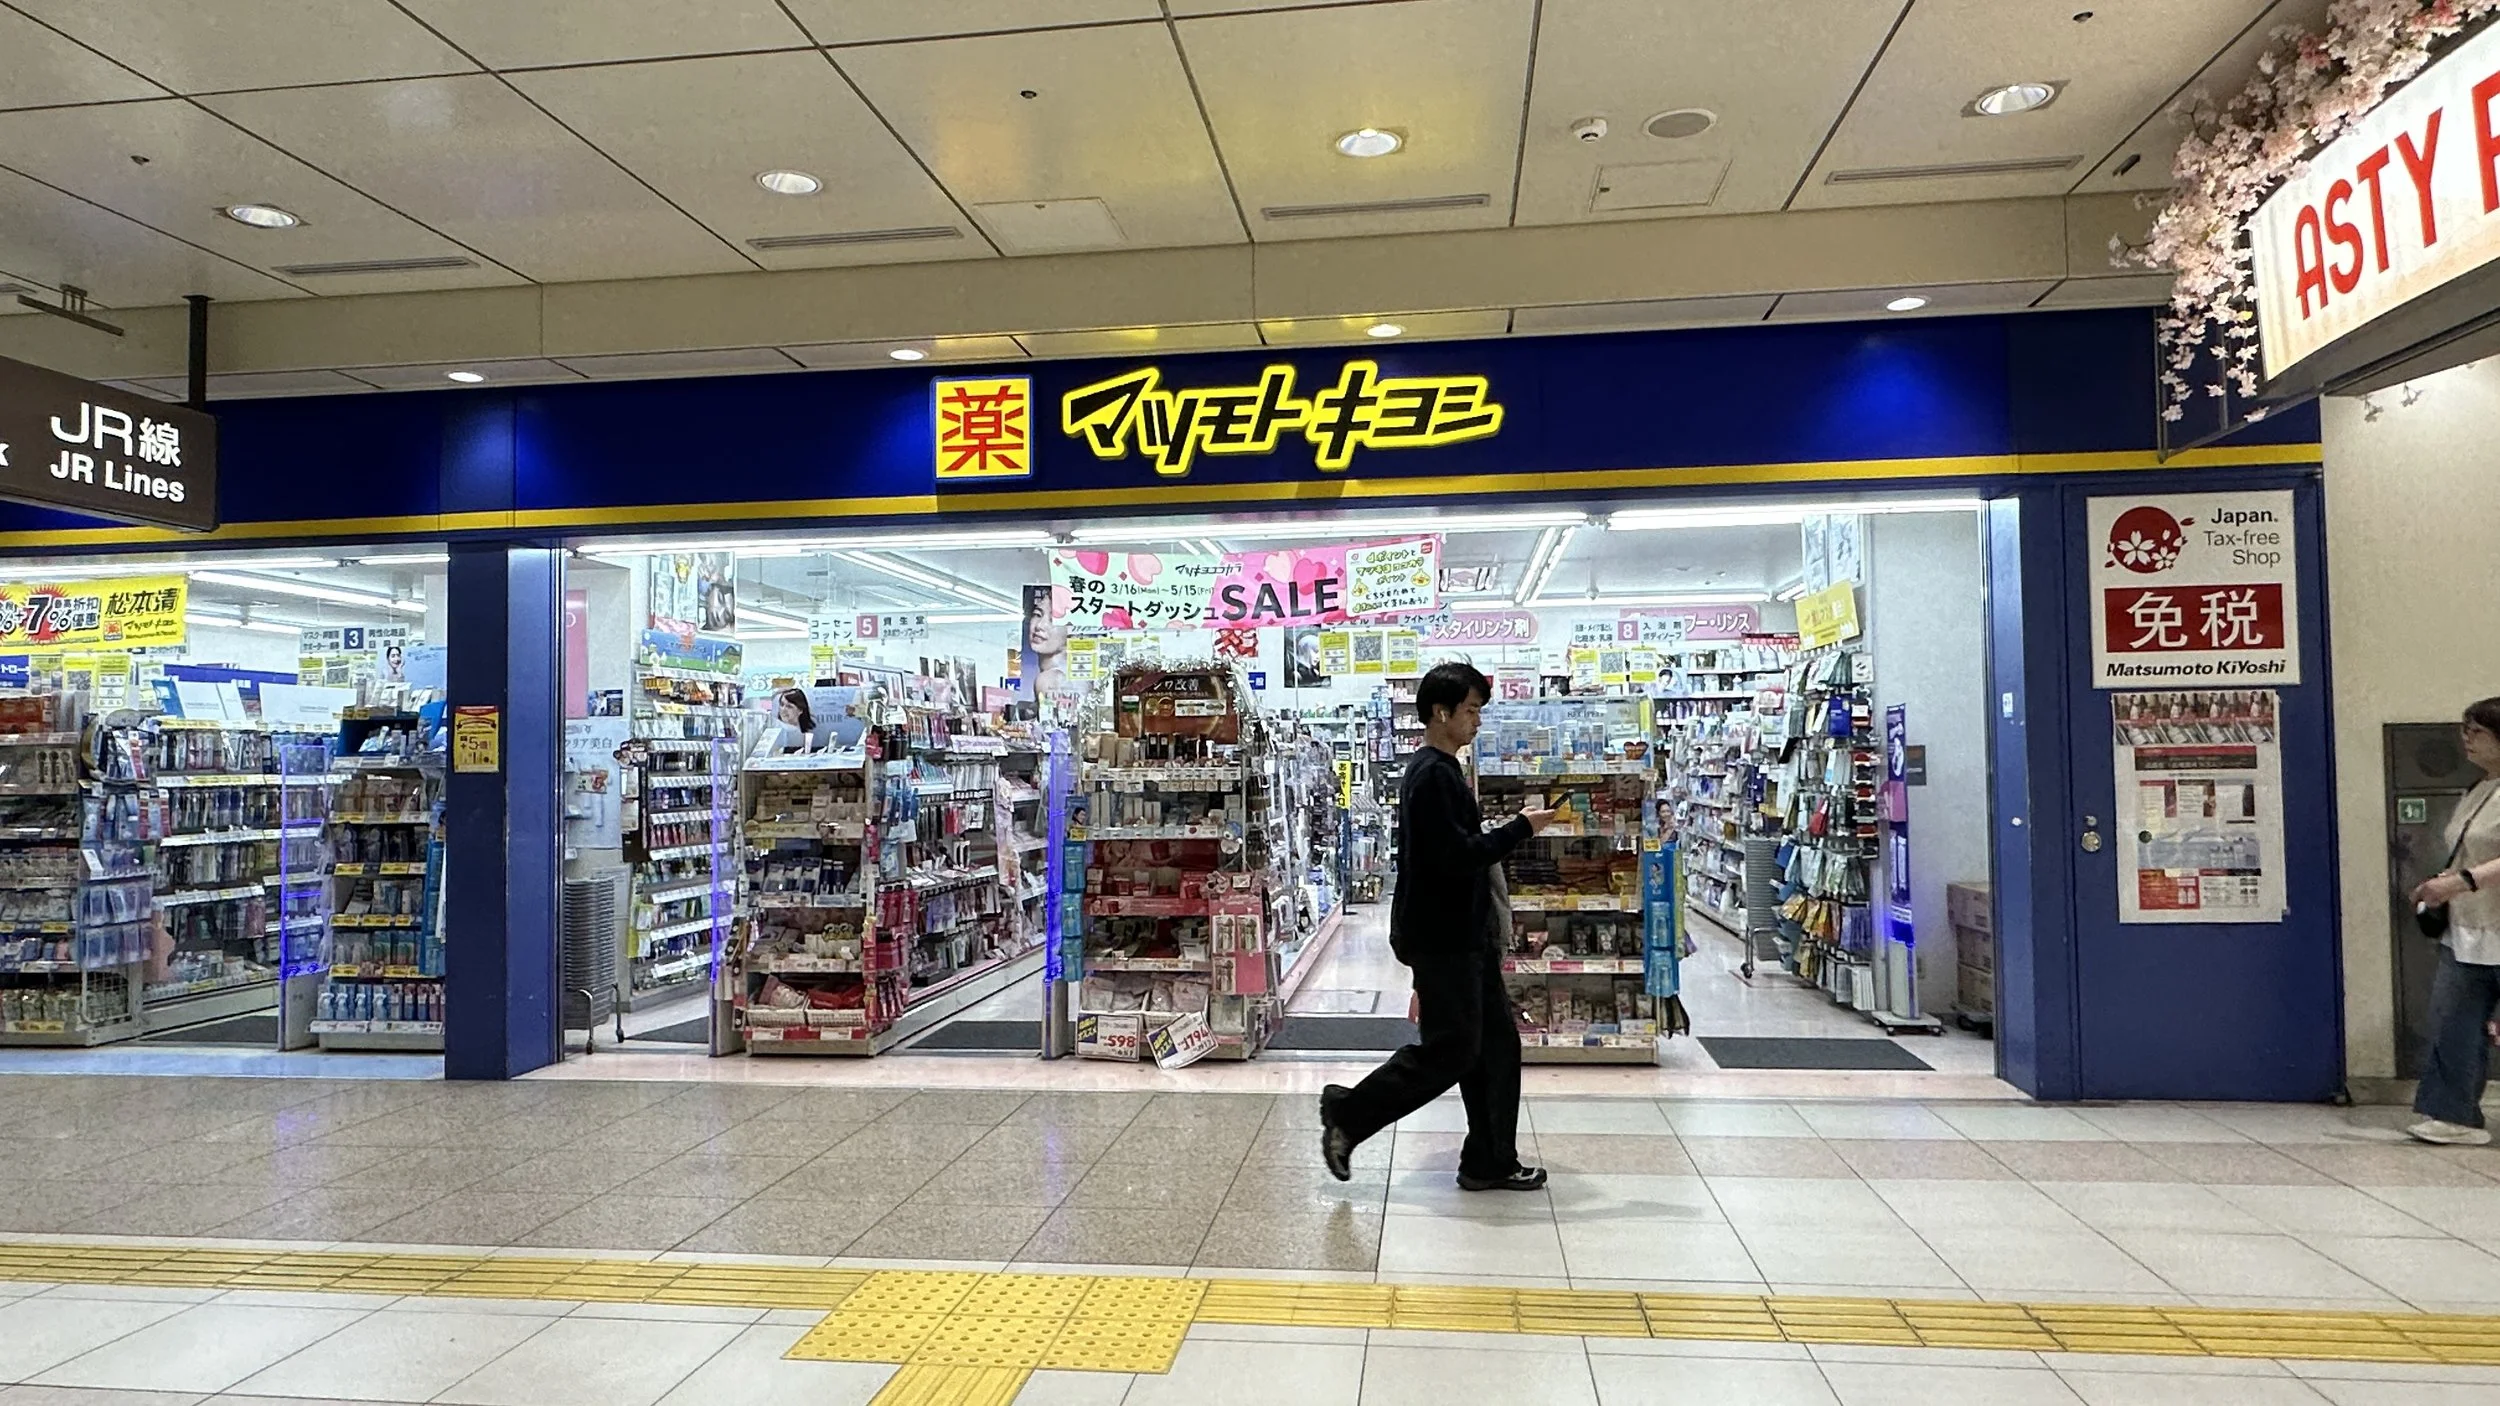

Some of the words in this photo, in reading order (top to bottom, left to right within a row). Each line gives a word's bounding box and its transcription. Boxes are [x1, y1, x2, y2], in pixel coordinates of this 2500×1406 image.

[2294, 106, 2443, 321] ASTY
[1065, 362, 1502, 473] マツモトキヨシ
[51, 402, 182, 468] JR線
[940, 386, 1026, 473] 薬
[50, 450, 95, 484] JR
[104, 460, 186, 503] Lines
[2211, 508, 2278, 527] Japan.
[2203, 529, 2280, 546] Tax-free
[2232, 549, 2281, 568] Shop
[1069, 576, 1105, 594] 春の
[1070, 596, 1219, 621] スタートダッシュ
[1221, 577, 1340, 621] SALE
[811, 619, 852, 628] コーセー
[862, 618, 873, 635] 5
[2126, 589, 2264, 649] 免税
[349, 630, 359, 647] 3
[811, 631, 852, 640] コットン
[1622, 622, 1633, 639] 8
[2106, 662, 2213, 677] Matsumoto
[2216, 659, 2287, 674] KiYoshi
[1107, 1035, 1136, 1048] 598
